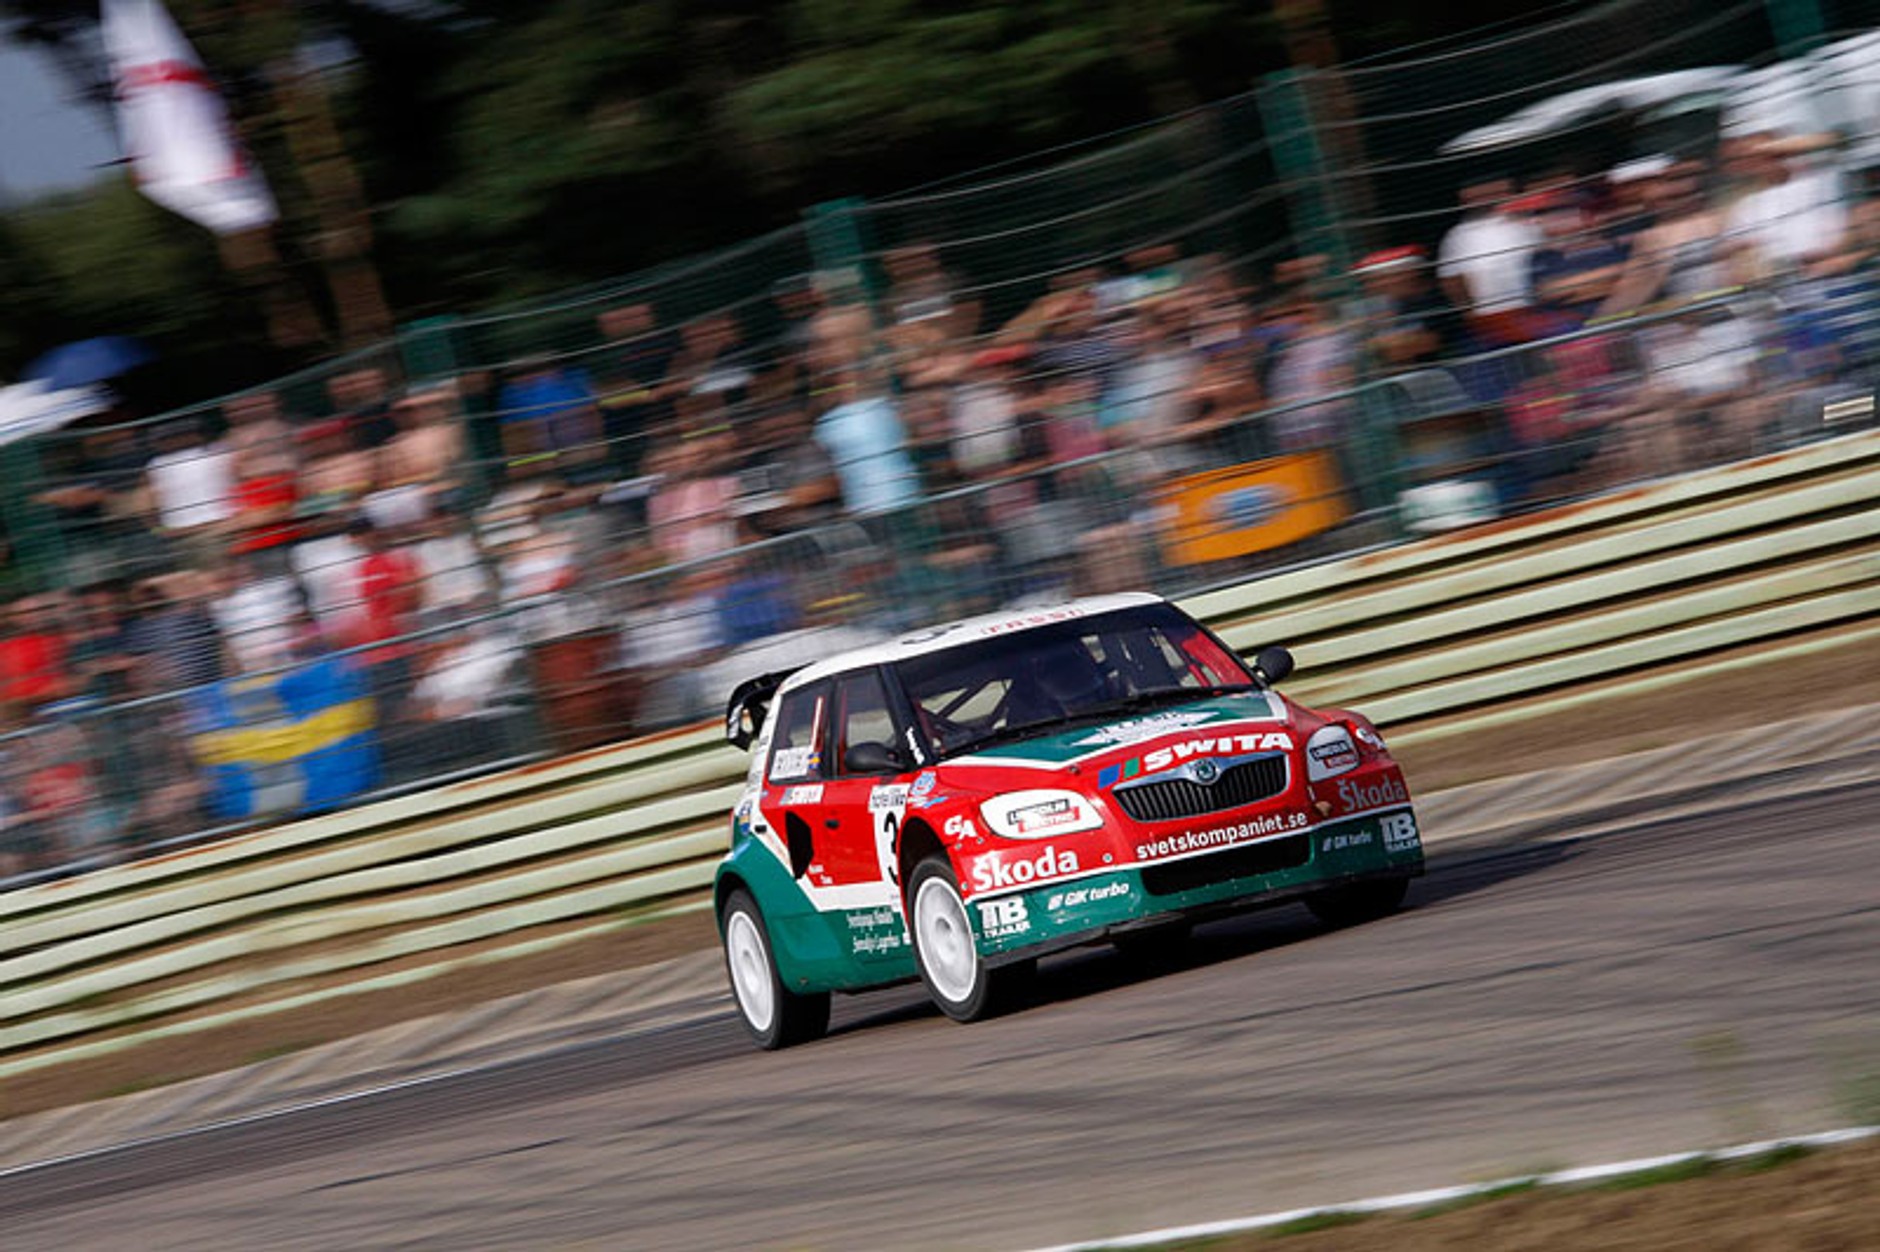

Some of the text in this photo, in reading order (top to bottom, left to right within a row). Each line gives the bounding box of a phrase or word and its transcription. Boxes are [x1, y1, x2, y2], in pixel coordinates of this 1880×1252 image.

[1143, 733, 1294, 772] SWITA
[1337, 775, 1407, 812] Škoda
[1136, 812, 1308, 860] svetskompaniet.se
[972, 846, 1079, 892] Škoda
[1089, 882, 1130, 901] turbo
